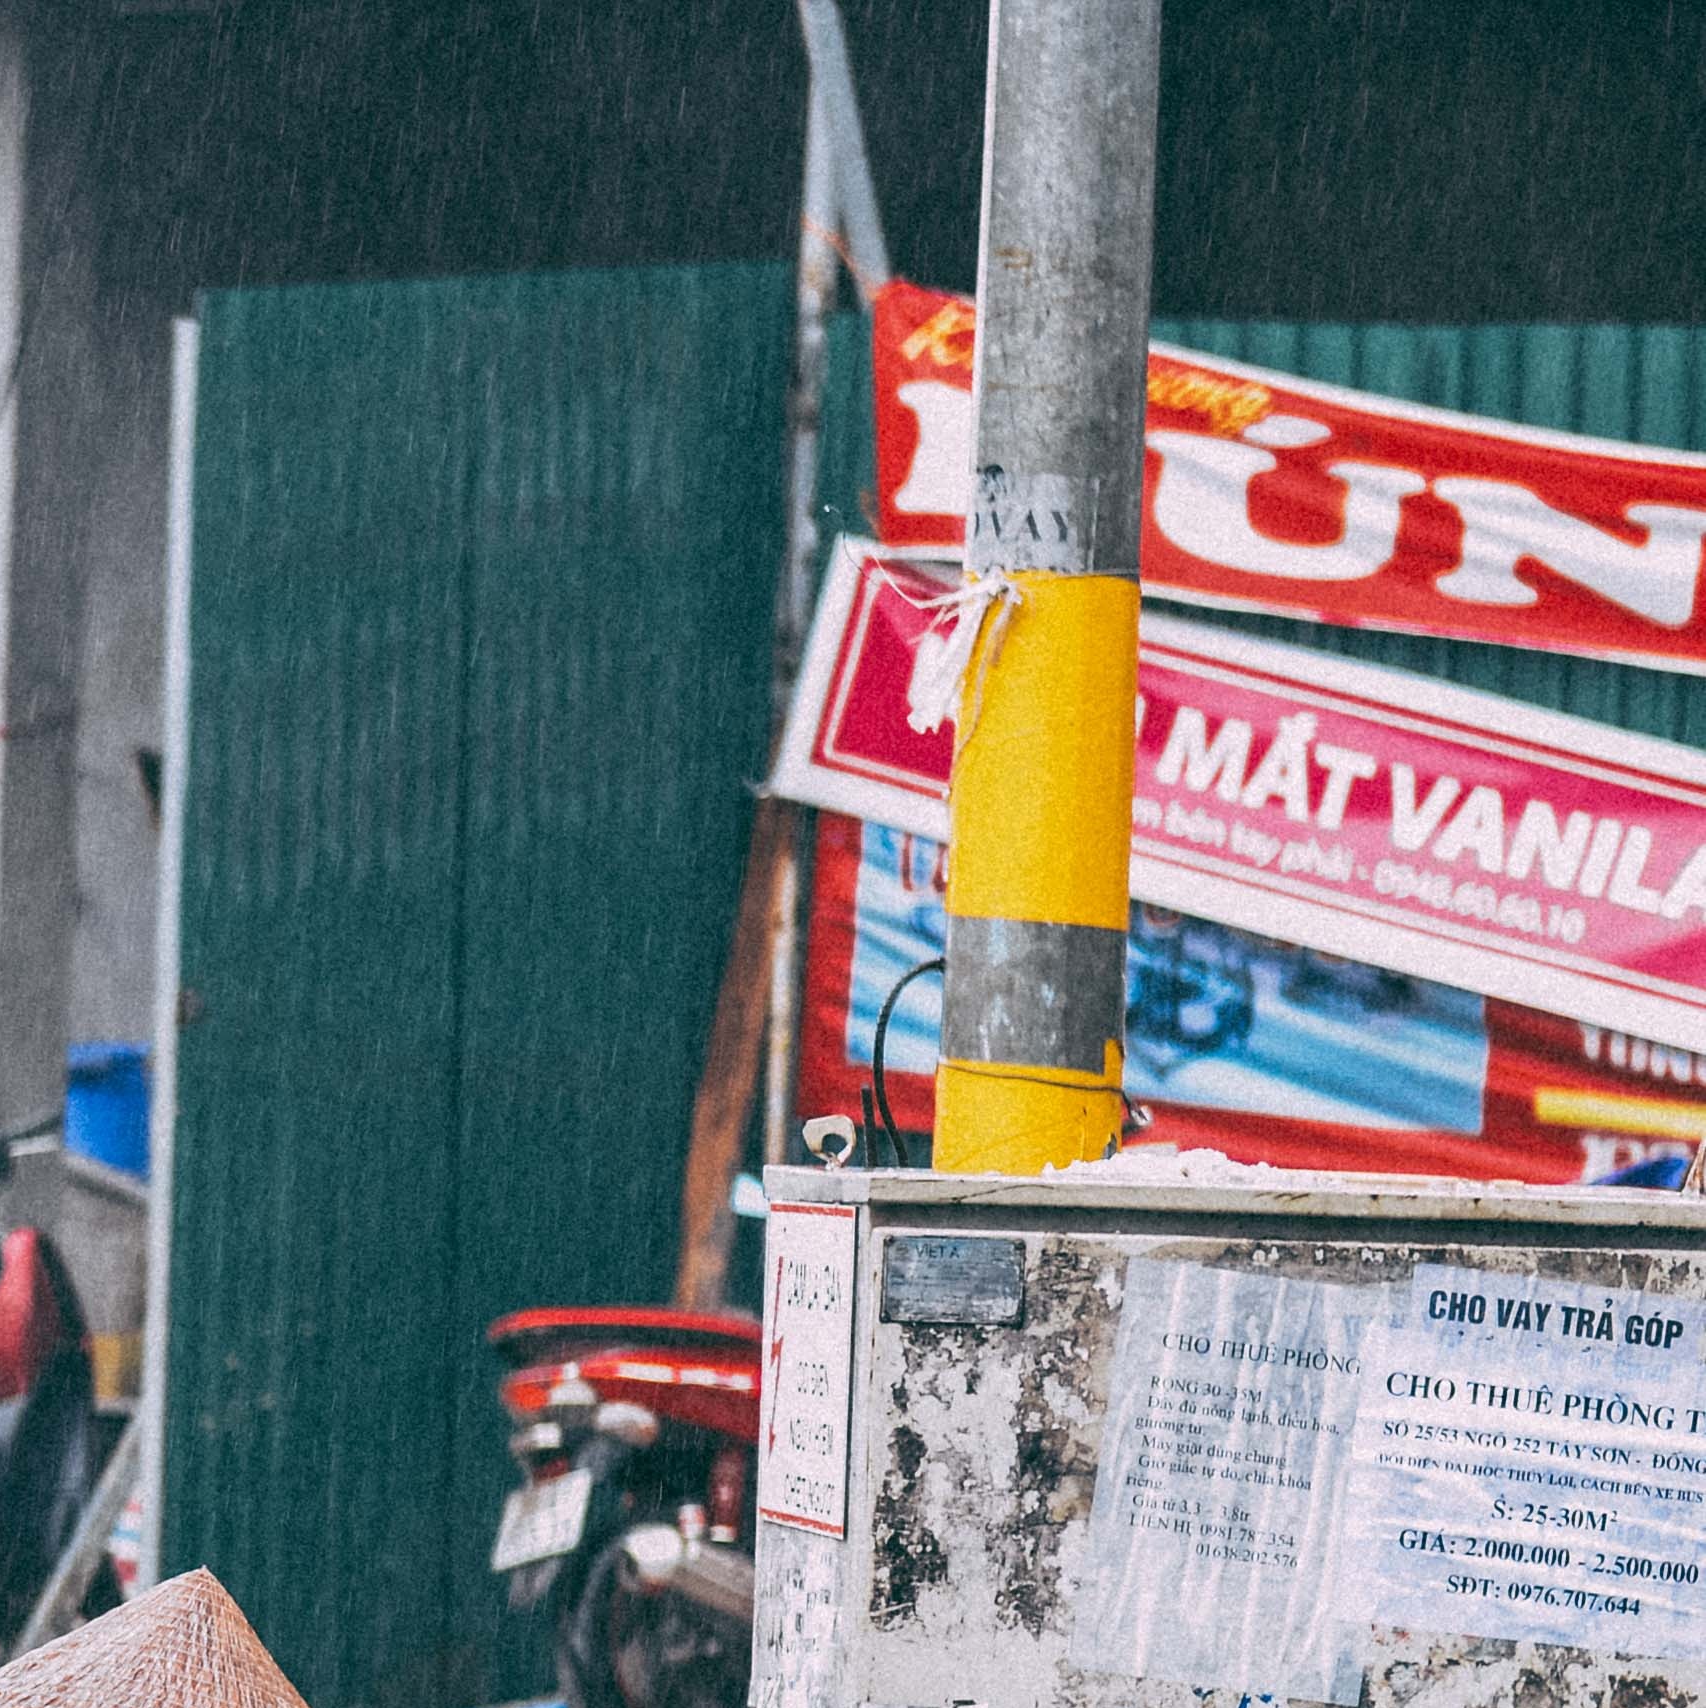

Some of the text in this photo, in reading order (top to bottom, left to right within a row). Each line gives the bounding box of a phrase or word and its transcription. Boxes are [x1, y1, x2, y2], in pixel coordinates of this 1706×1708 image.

[1154, 706, 1377, 831] MÁT
[1428, 1290, 1684, 1350] CHO VAY TRẢ GÓP
[1163, 1333, 1210, 1354] CHO
[1283, 1347, 1362, 1375] PHÒNG
[1202, 1383, 1221, 1398] 30
[1386, 1371, 1456, 1401] CHO
[1466, 1383, 1553, 1415] THUÊ
[1562, 1392, 1675, 1431] PHÒNG
[1414, 1424, 1459, 1445] 25/53
[1513, 1436, 1541, 1454] 252
[1654, 1486, 1674, 1500] XE
[1677, 1488, 1704, 1503] BUS
[1399, 1528, 1456, 1553] GIÁ:
[1464, 1537, 1571, 1569] 2.000.000
[1592, 1553, 1699, 1585] 2.500.000
[1446, 1574, 1640, 1616] SĐT: 0976.707.644
